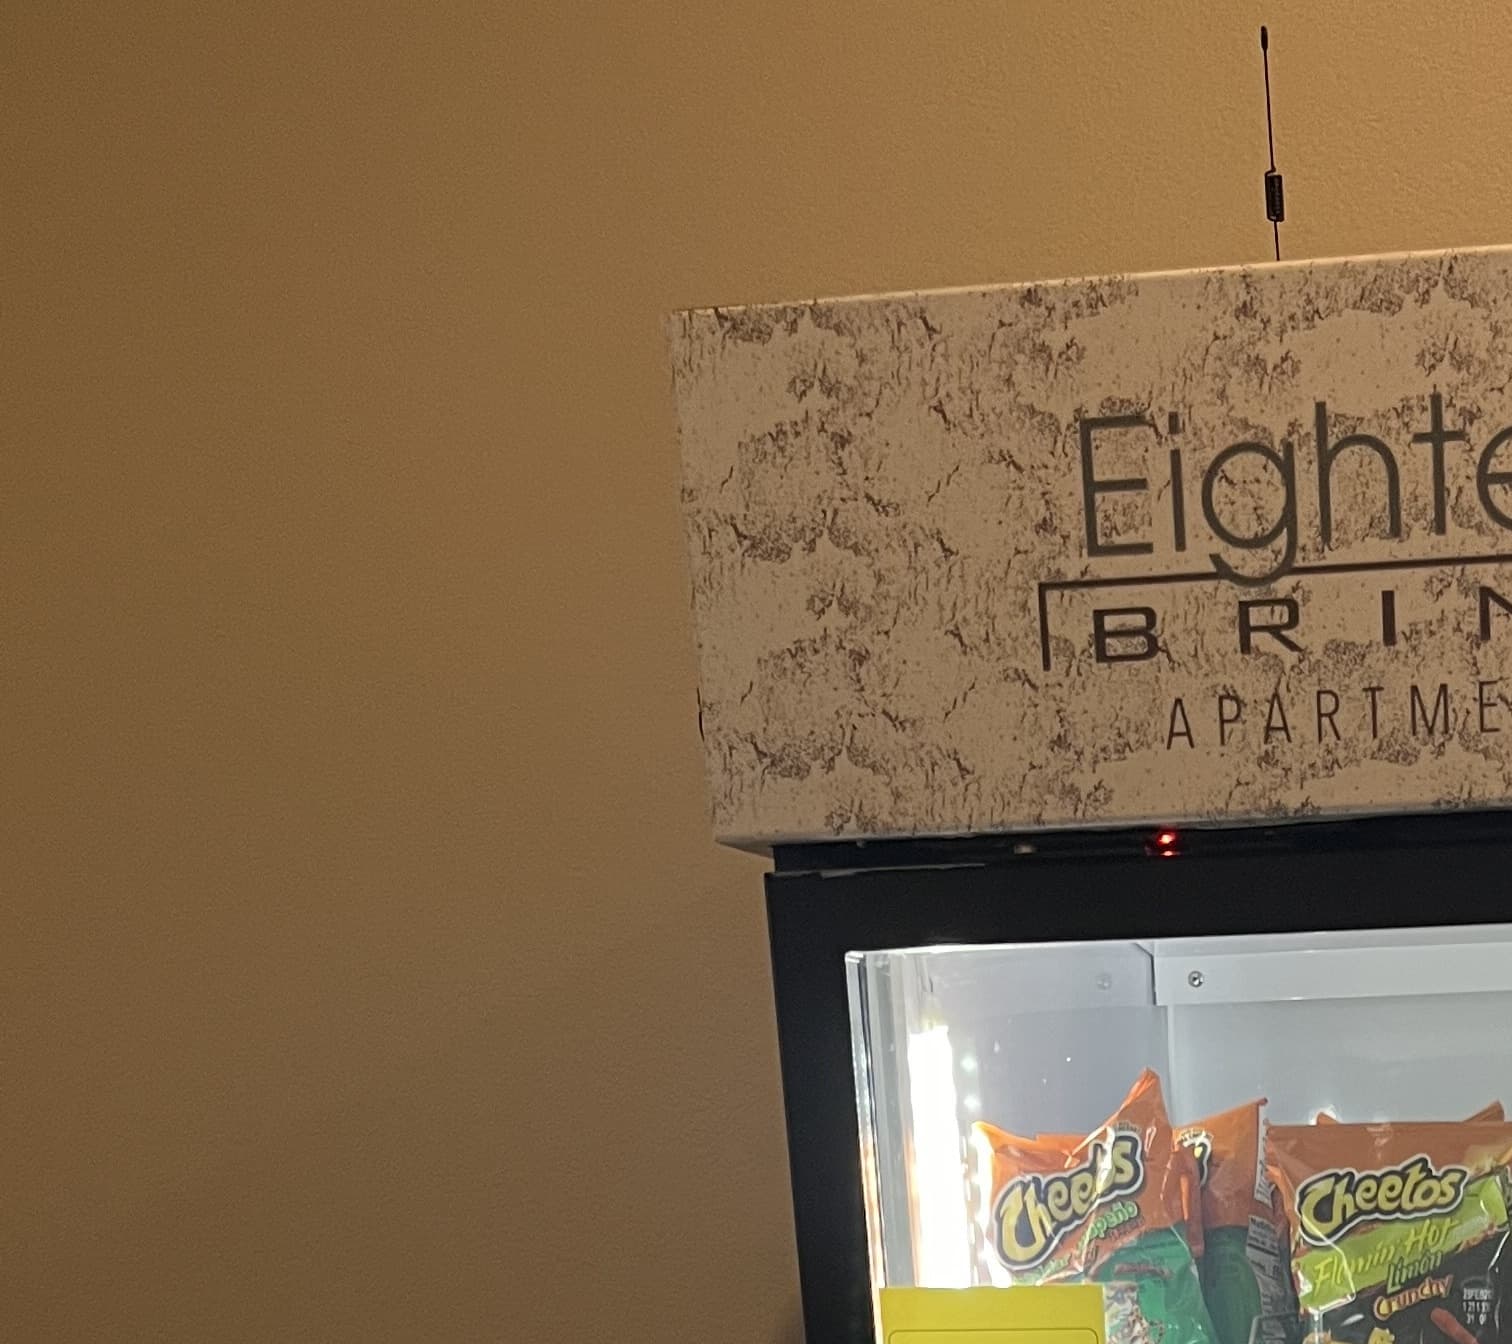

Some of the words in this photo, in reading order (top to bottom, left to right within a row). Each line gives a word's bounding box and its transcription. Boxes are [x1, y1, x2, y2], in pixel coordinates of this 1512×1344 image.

[1300, 1156, 1466, 1242] Cheetos
[1405, 1217, 1459, 1255] Hot
[1387, 1252, 1443, 1294] Limón
[1374, 1274, 1454, 1320] Crunchy
